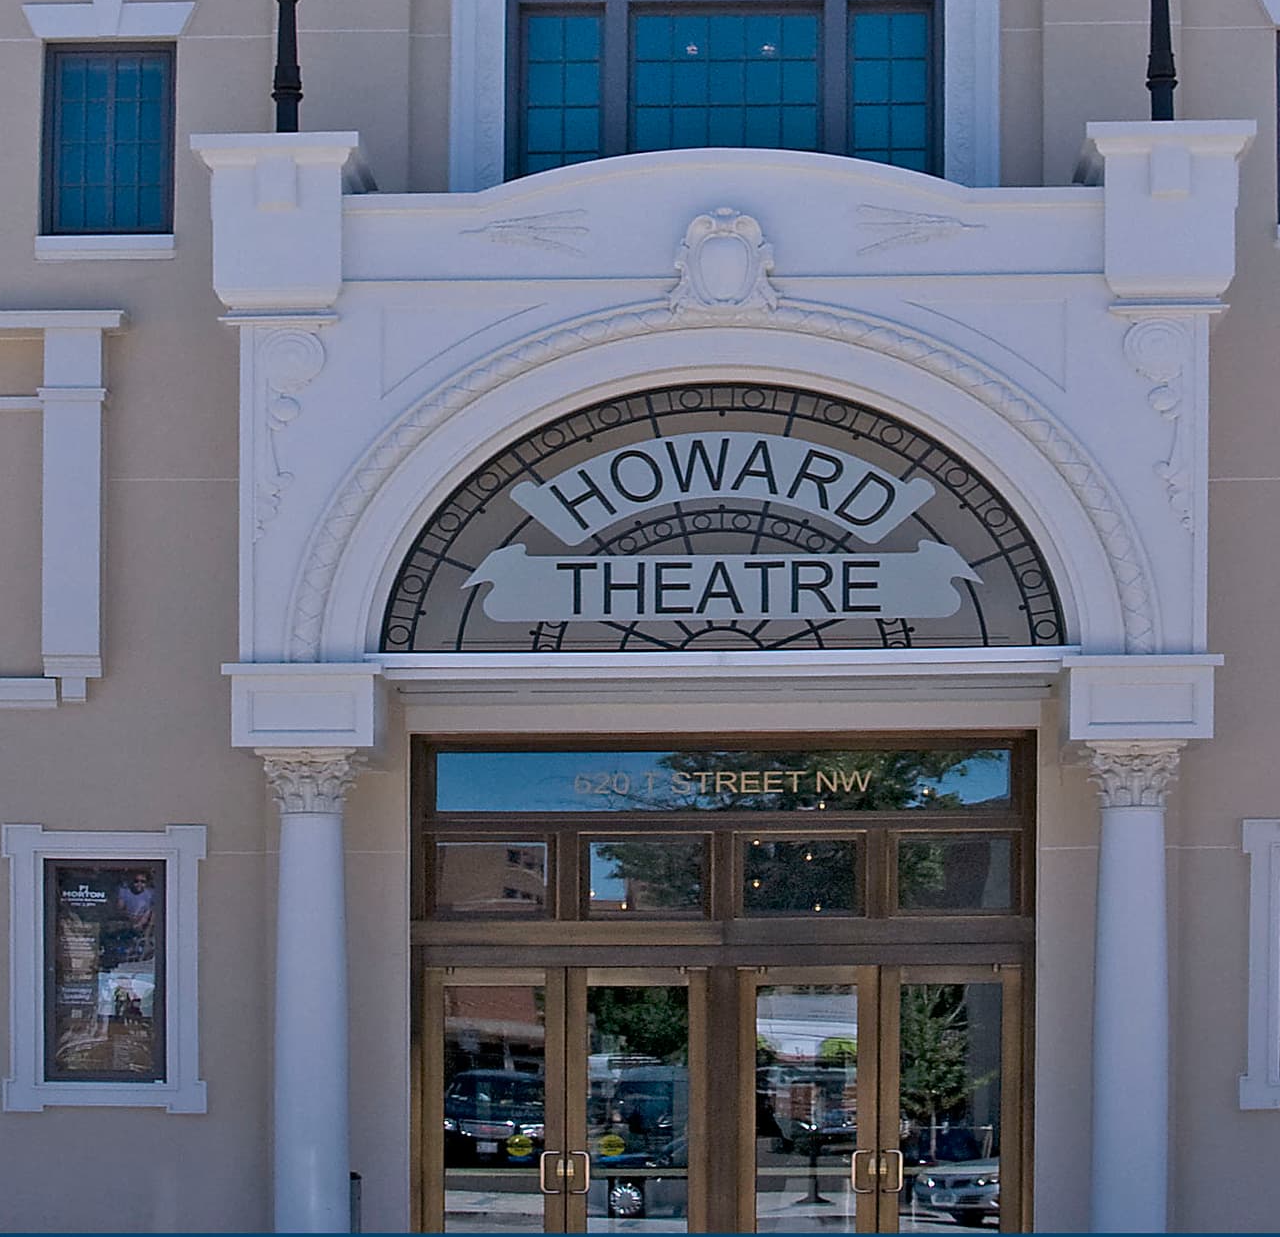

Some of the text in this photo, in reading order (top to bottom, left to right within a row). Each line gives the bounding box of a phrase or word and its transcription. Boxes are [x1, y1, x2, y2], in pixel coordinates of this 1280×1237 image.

[549, 438, 896, 530] HOWARD
[556, 560, 882, 615] THEATRE
[575, 770, 872, 795] 620 T STREET NW
